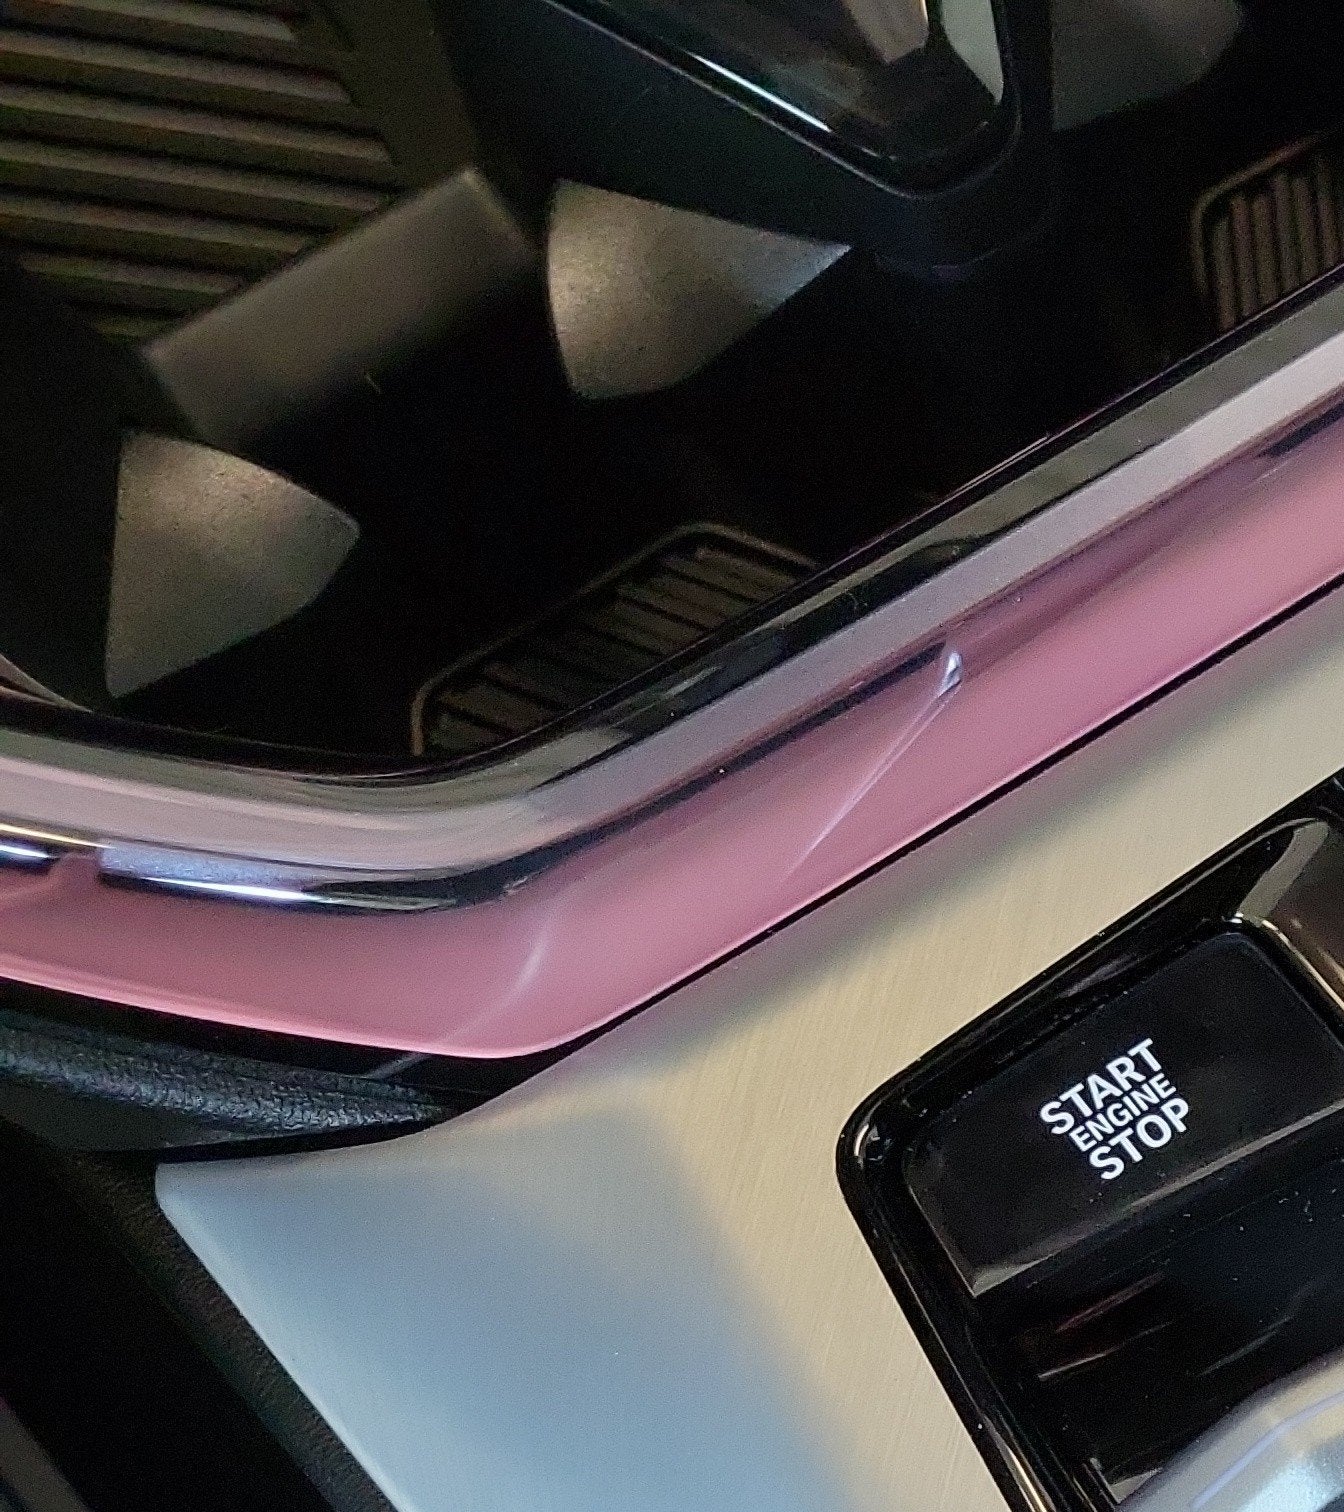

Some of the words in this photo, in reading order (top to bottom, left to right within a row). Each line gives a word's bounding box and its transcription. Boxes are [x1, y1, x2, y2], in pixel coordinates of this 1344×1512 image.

[1039, 1038, 1163, 1135] START
[1069, 1072, 1177, 1152] ENGINE
[1088, 1097, 1190, 1180] STOP
